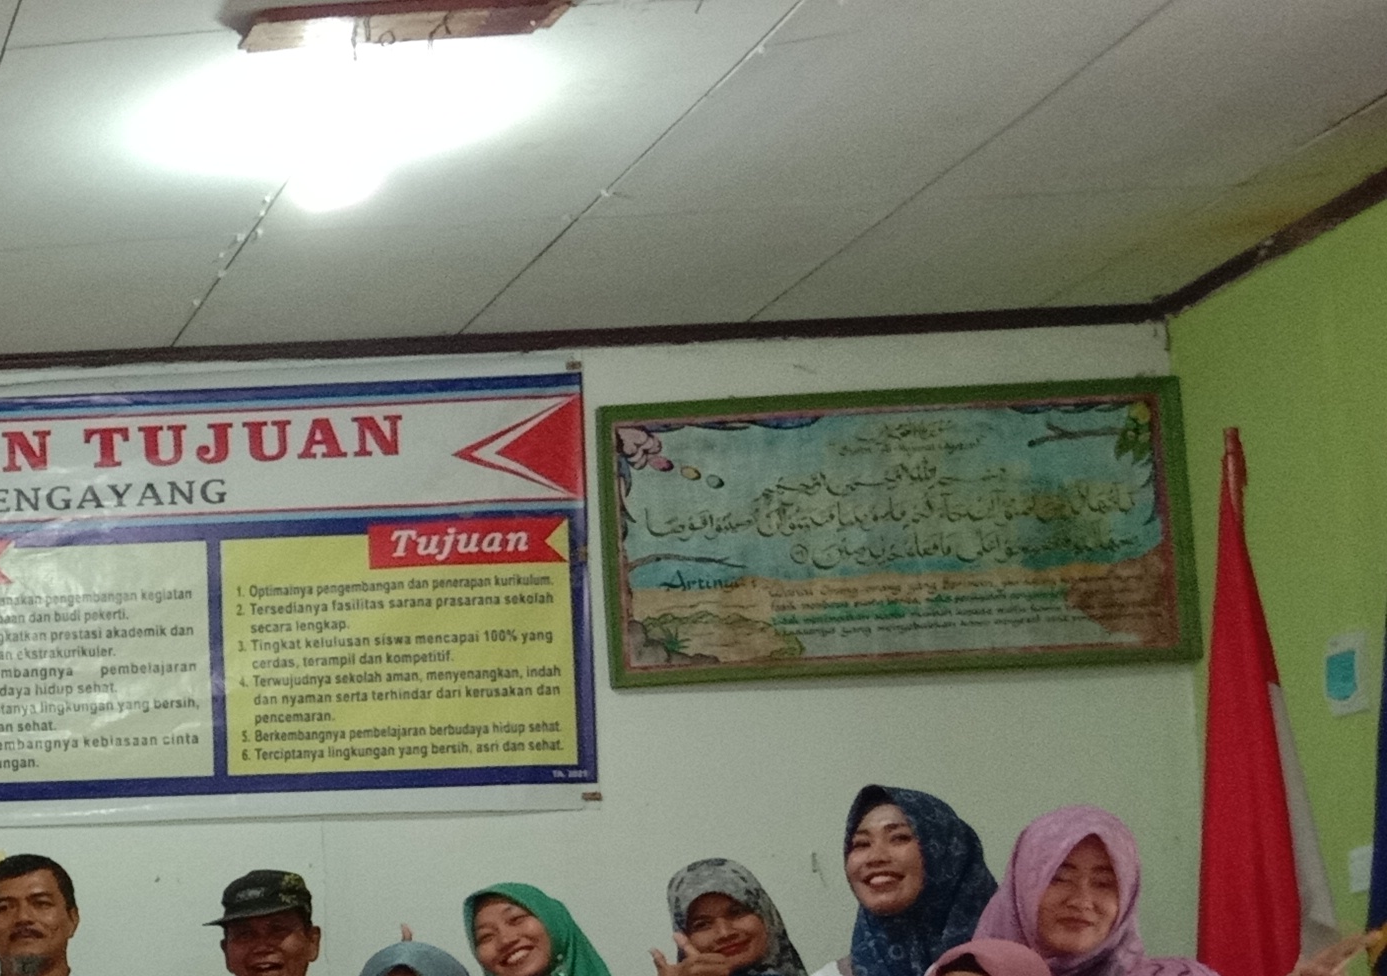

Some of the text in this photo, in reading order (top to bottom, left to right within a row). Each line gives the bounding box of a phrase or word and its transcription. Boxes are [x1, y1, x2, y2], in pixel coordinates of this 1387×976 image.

[83, 414, 404, 469] TUJUAN
[390, 526, 530, 562] Tujuan
[248, 573, 555, 600] Optimalnya pengembangan dan penerapan kurikulum.
[140, 589, 193, 605] kegiatan
[250, 592, 554, 616] Tersedianya fasilitas sarana prasarana sekolah
[29, 608, 131, 624] dan budi pekerti.
[50, 624, 195, 643] prestasi akademik dan
[250, 619, 351, 635] secara lengkap.
[251, 628, 554, 654] Tingkat kelulusan siswa mencapai 100% yang
[302, 652, 356, 668] terampil
[358, 652, 383, 666] dan
[385, 649, 455, 665] kompetitif.
[99, 662, 197, 679] pembelajaran
[253, 664, 562, 689] Terwujudnya sekolah aman, menyenangkan, indah
[34, 682, 74, 697] hidup
[253, 683, 561, 708] dan nyaman serta terhindar dari kerusakan dan
[153, 697, 200, 711] bersih,
[16, 719, 61, 733] sehat.
[254, 711, 336, 727] pencemaran.
[82, 735, 158, 748] kebiasaan
[162, 732, 200, 746] cinta
[254, 729, 347, 744] Berkembangnya
[348, 725, 427, 741] pembelajaran
[429, 723, 490, 738] berbudaya
[492, 721, 526, 737] hidup
[255, 739, 565, 763] Terciptanya lingkungan yang bersih, asri dan sehat.
